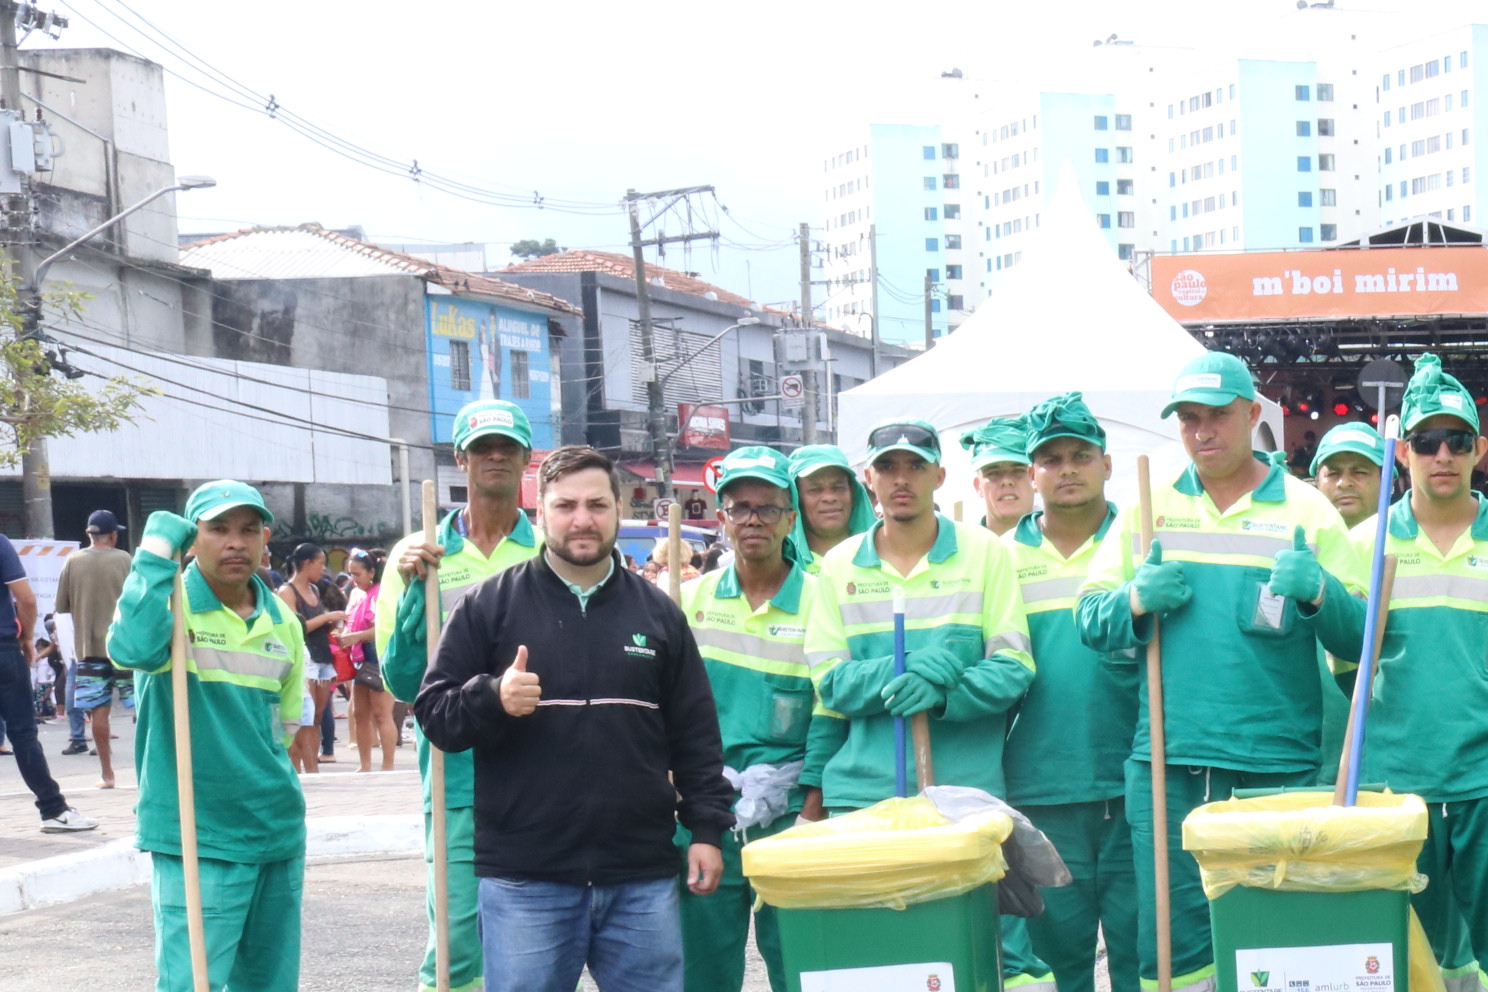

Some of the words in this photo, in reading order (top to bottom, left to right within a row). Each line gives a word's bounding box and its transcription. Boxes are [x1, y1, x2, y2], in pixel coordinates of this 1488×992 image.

[1174, 279, 1206, 290] paulo
[1253, 269, 1343, 296] m'boi
[1355, 267, 1459, 293] mirim
[451, 574, 470, 583] PAULO
[858, 586, 870, 594] SÃO
[717, 618, 736, 626] PAULO
[210, 638, 226, 646] PAULO
[1315, 982, 1350, 992] amlurb
